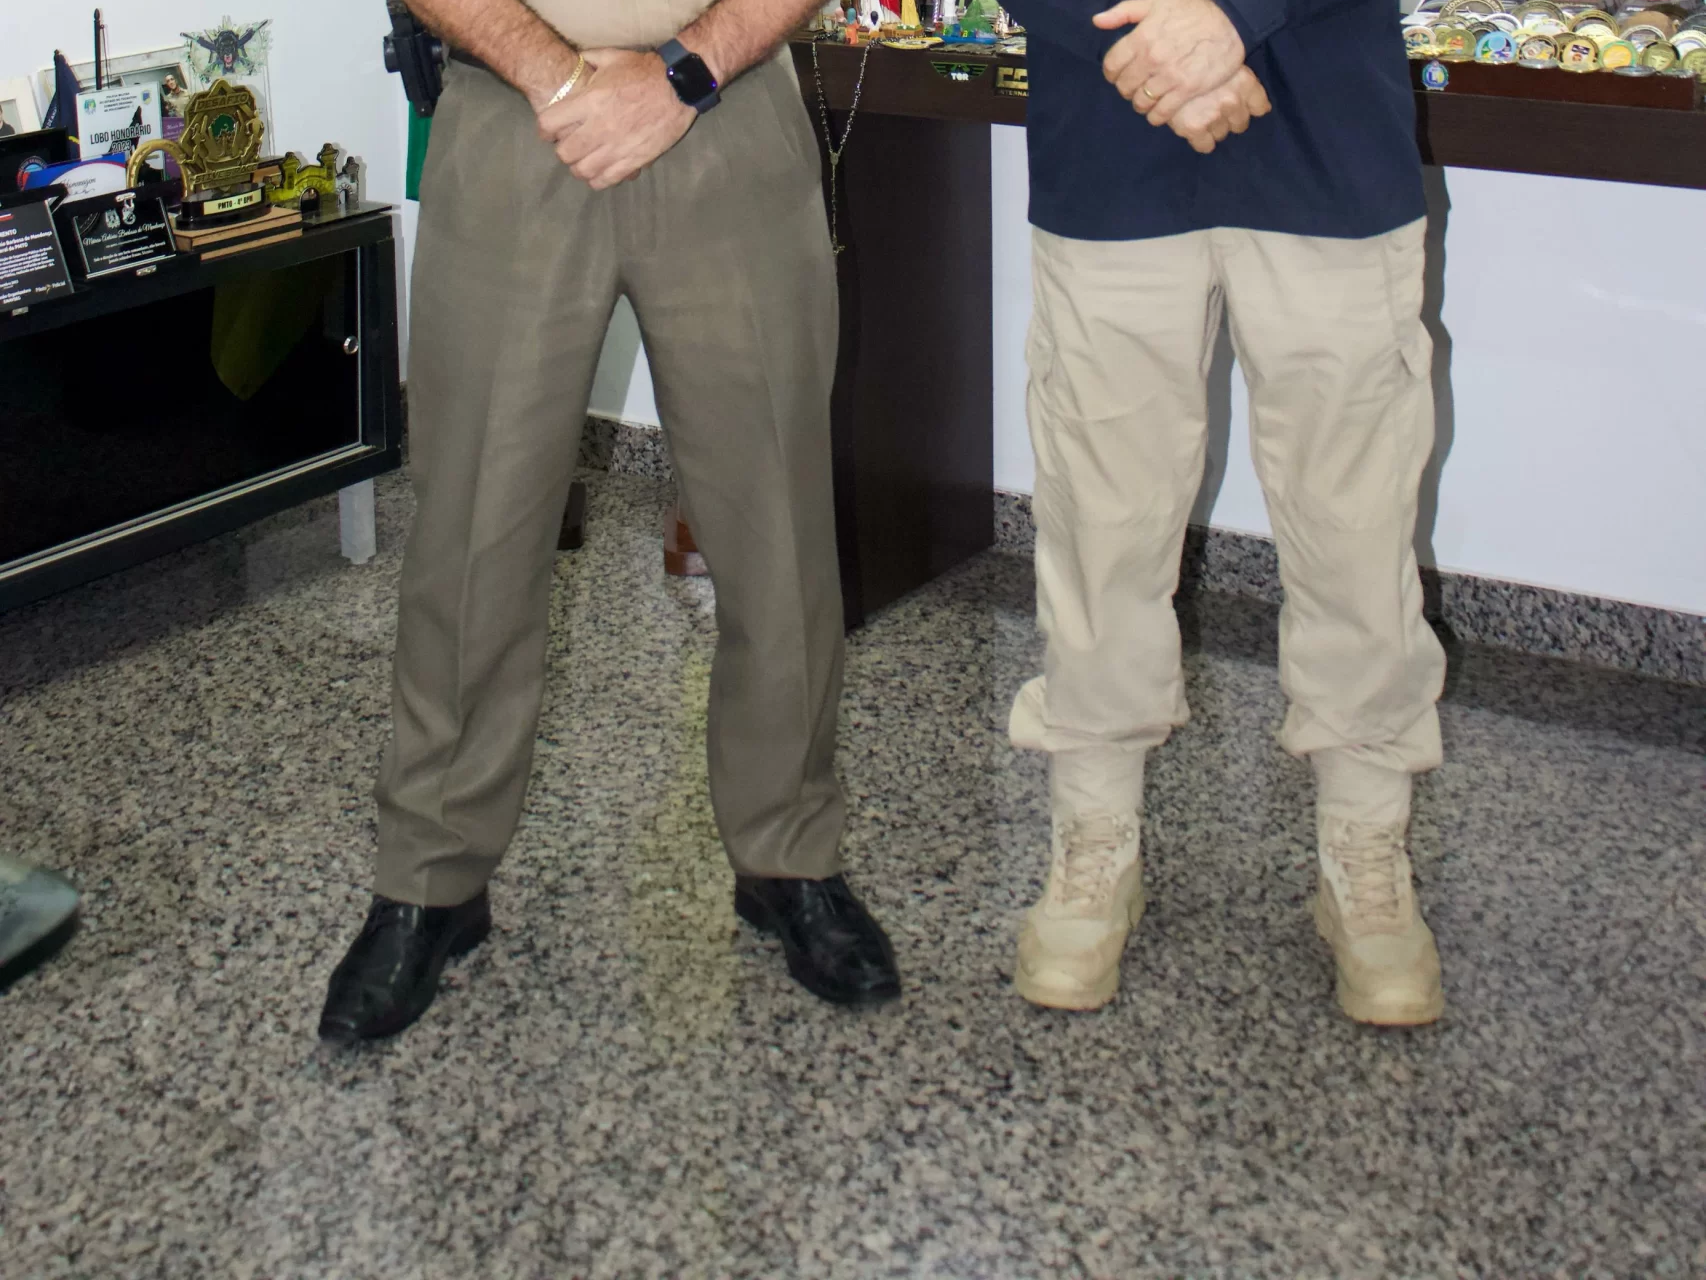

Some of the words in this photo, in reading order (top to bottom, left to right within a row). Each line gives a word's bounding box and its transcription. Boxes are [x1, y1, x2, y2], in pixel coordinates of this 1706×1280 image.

[197, 93, 249, 109] DESAFIO
[90, 131, 109, 145] LOBO
[110, 123, 152, 140] HONORÁRIO
[111, 140, 132, 153] 2023
[218, 200, 232, 210] PMTO
